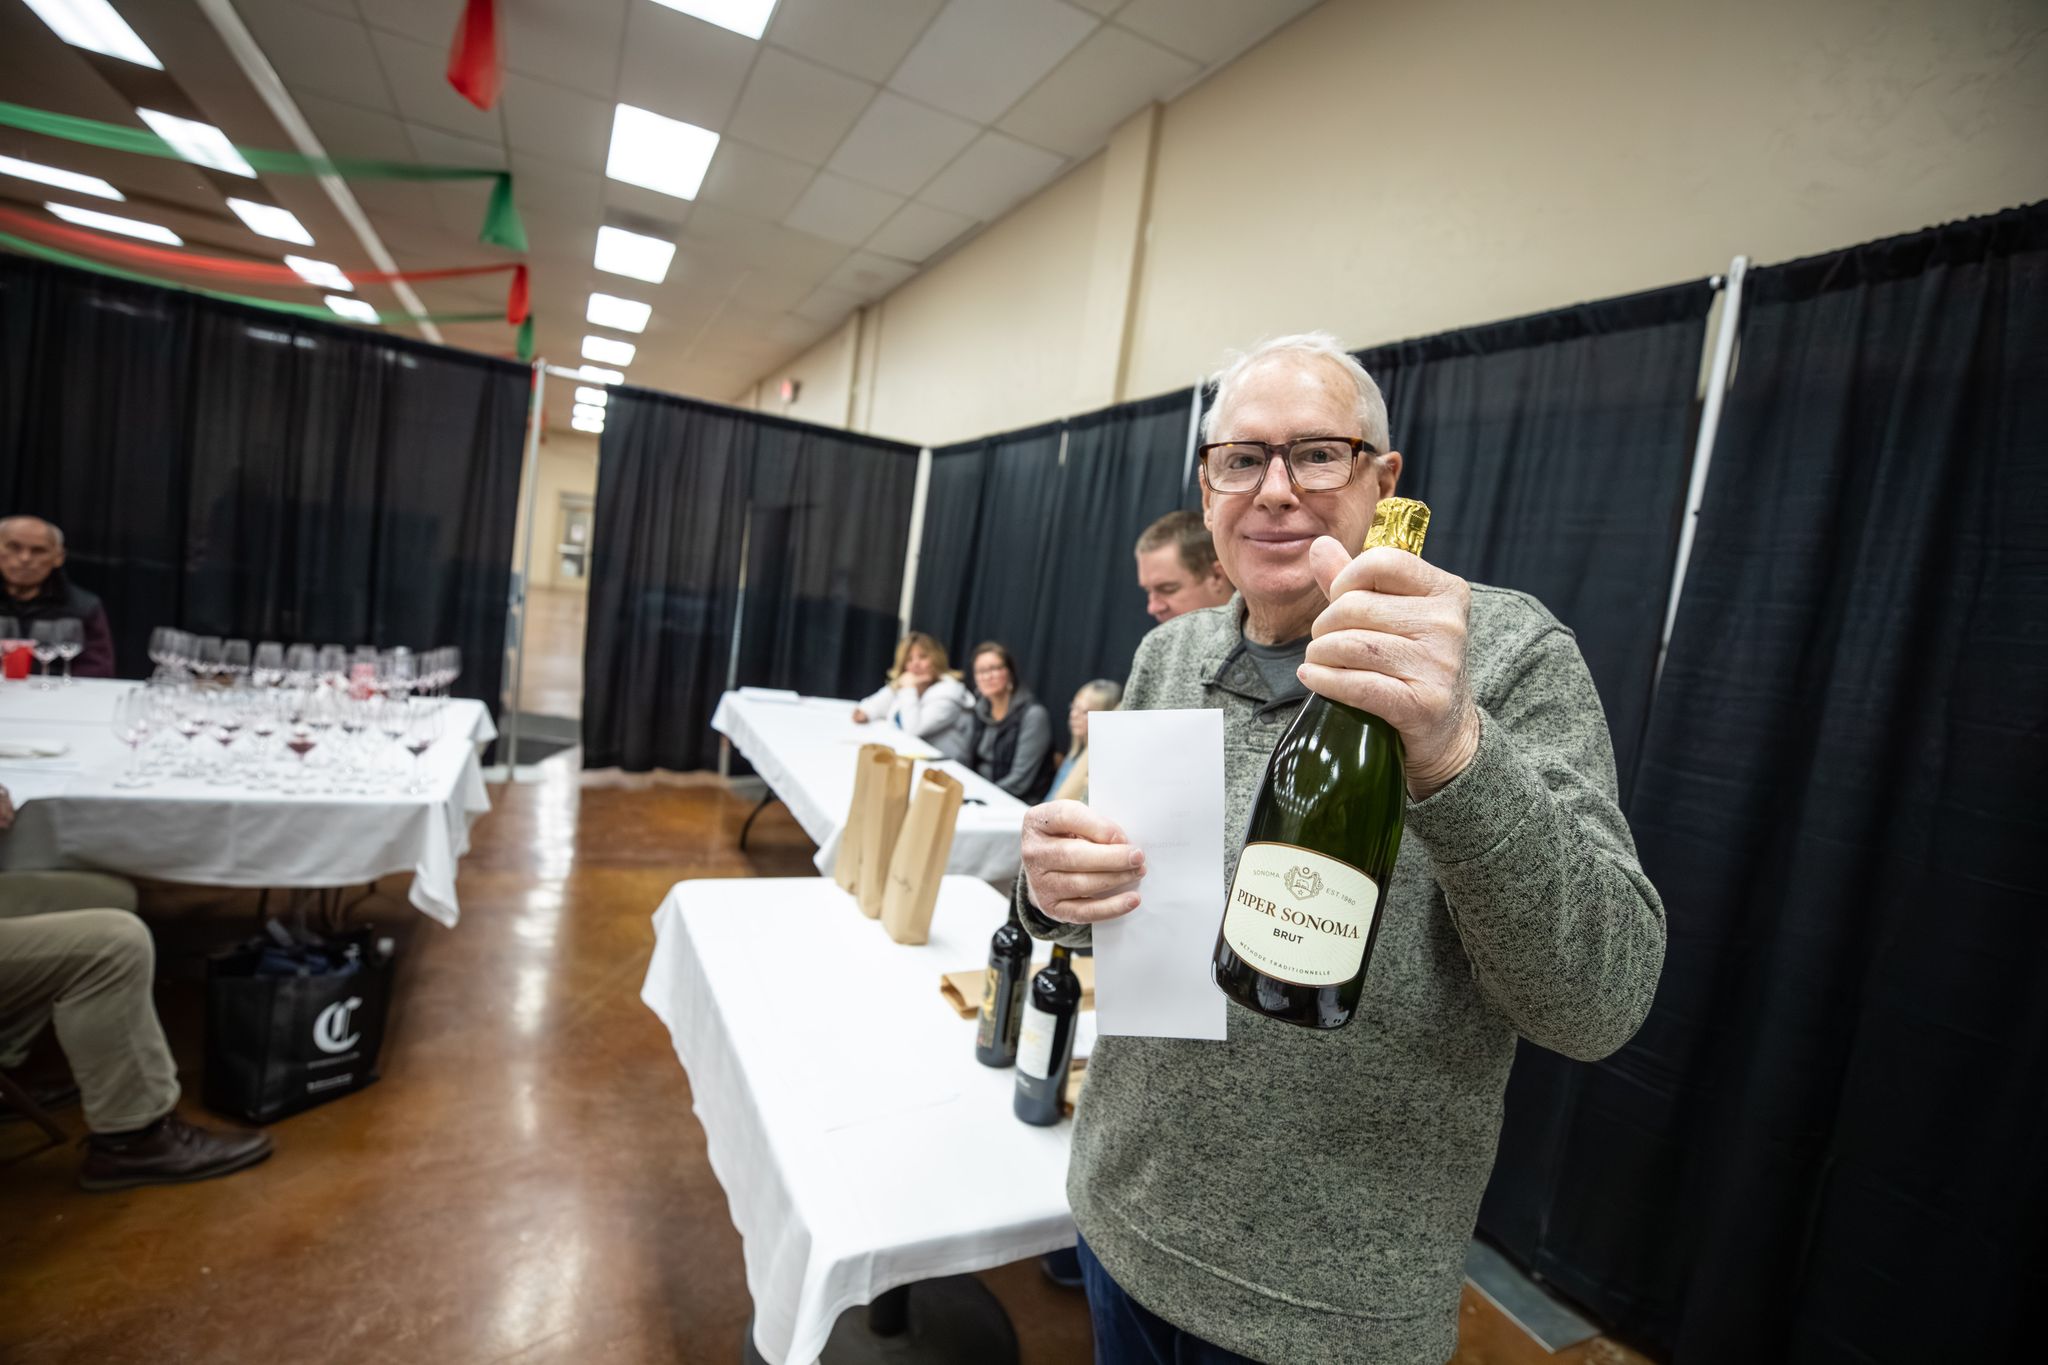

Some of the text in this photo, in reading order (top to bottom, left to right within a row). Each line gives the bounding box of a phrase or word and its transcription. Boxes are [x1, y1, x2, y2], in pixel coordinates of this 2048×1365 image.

[1253, 869, 1280, 878] SONOMA
[1341, 894, 1356, 906] 1980
[1237, 889, 1359, 939] PIPER SONOMA
[1273, 928, 1304, 944] BRUT
[1270, 959, 1331, 976] TRADITIONNELLE
